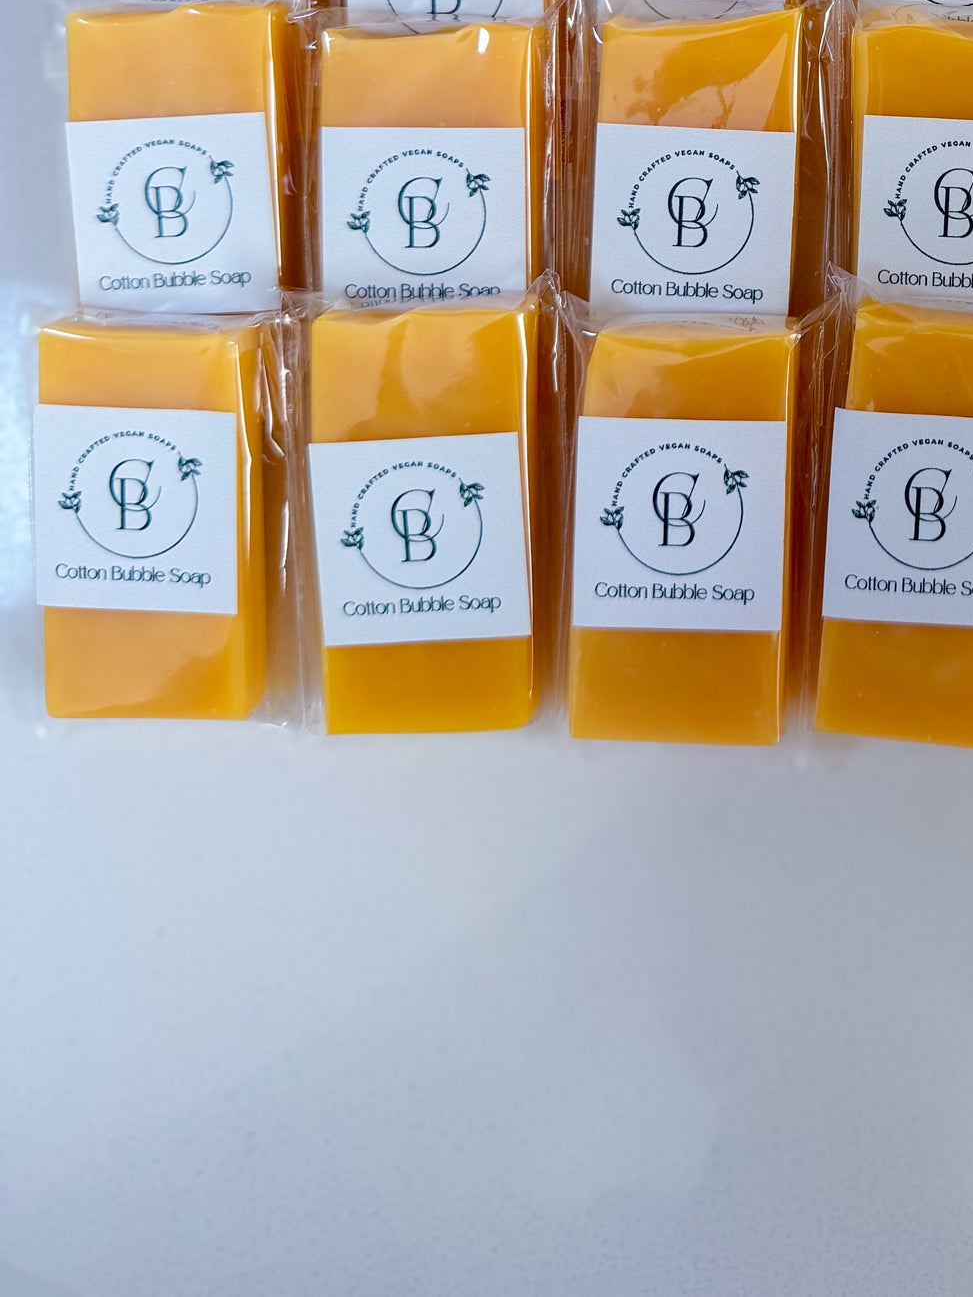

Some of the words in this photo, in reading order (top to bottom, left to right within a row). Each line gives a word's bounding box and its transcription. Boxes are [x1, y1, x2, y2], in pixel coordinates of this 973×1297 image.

[628, 183, 640, 211] HAND
[638, 153, 672, 182] CRAFTED
[674, 149, 705, 157] VEGAN
[707, 152, 736, 171] SOAPS
[895, 174, 907, 201] HAND
[905, 144, 938, 173] CRAFTED
[940, 140, 972, 148] VEGAN
[98, 275, 150, 291] Cotton
[153, 270, 207, 288] Bubble
[210, 270, 252, 288] Soap
[877, 269, 928, 286] Cotton
[344, 283, 396, 299] Cotton
[611, 278, 661, 296] Cotton
[665, 281, 719, 299] Bubble
[722, 284, 764, 304] Soap
[611, 480, 623, 509] HAND
[621, 447, 656, 479] CRAFTED
[658, 442, 691, 451] VEGAN
[693, 445, 723, 464] SOAPS
[863, 473, 876, 502] HAND
[874, 442, 909, 473] CRAFTED
[912, 437, 944, 446] VEGAN
[55, 563, 107, 580] Cotton
[111, 565, 165, 583] Bubble
[169, 568, 212, 589] Soap
[845, 574, 897, 592] Cotton
[901, 576, 957, 596] Bubble
[595, 582, 648, 599] Cotton
[652, 583, 708, 601] Bubble
[712, 584, 756, 605] Soap
[342, 601, 396, 617] Cotton
[399, 595, 455, 613] Bubble
[459, 595, 503, 613] Soap
